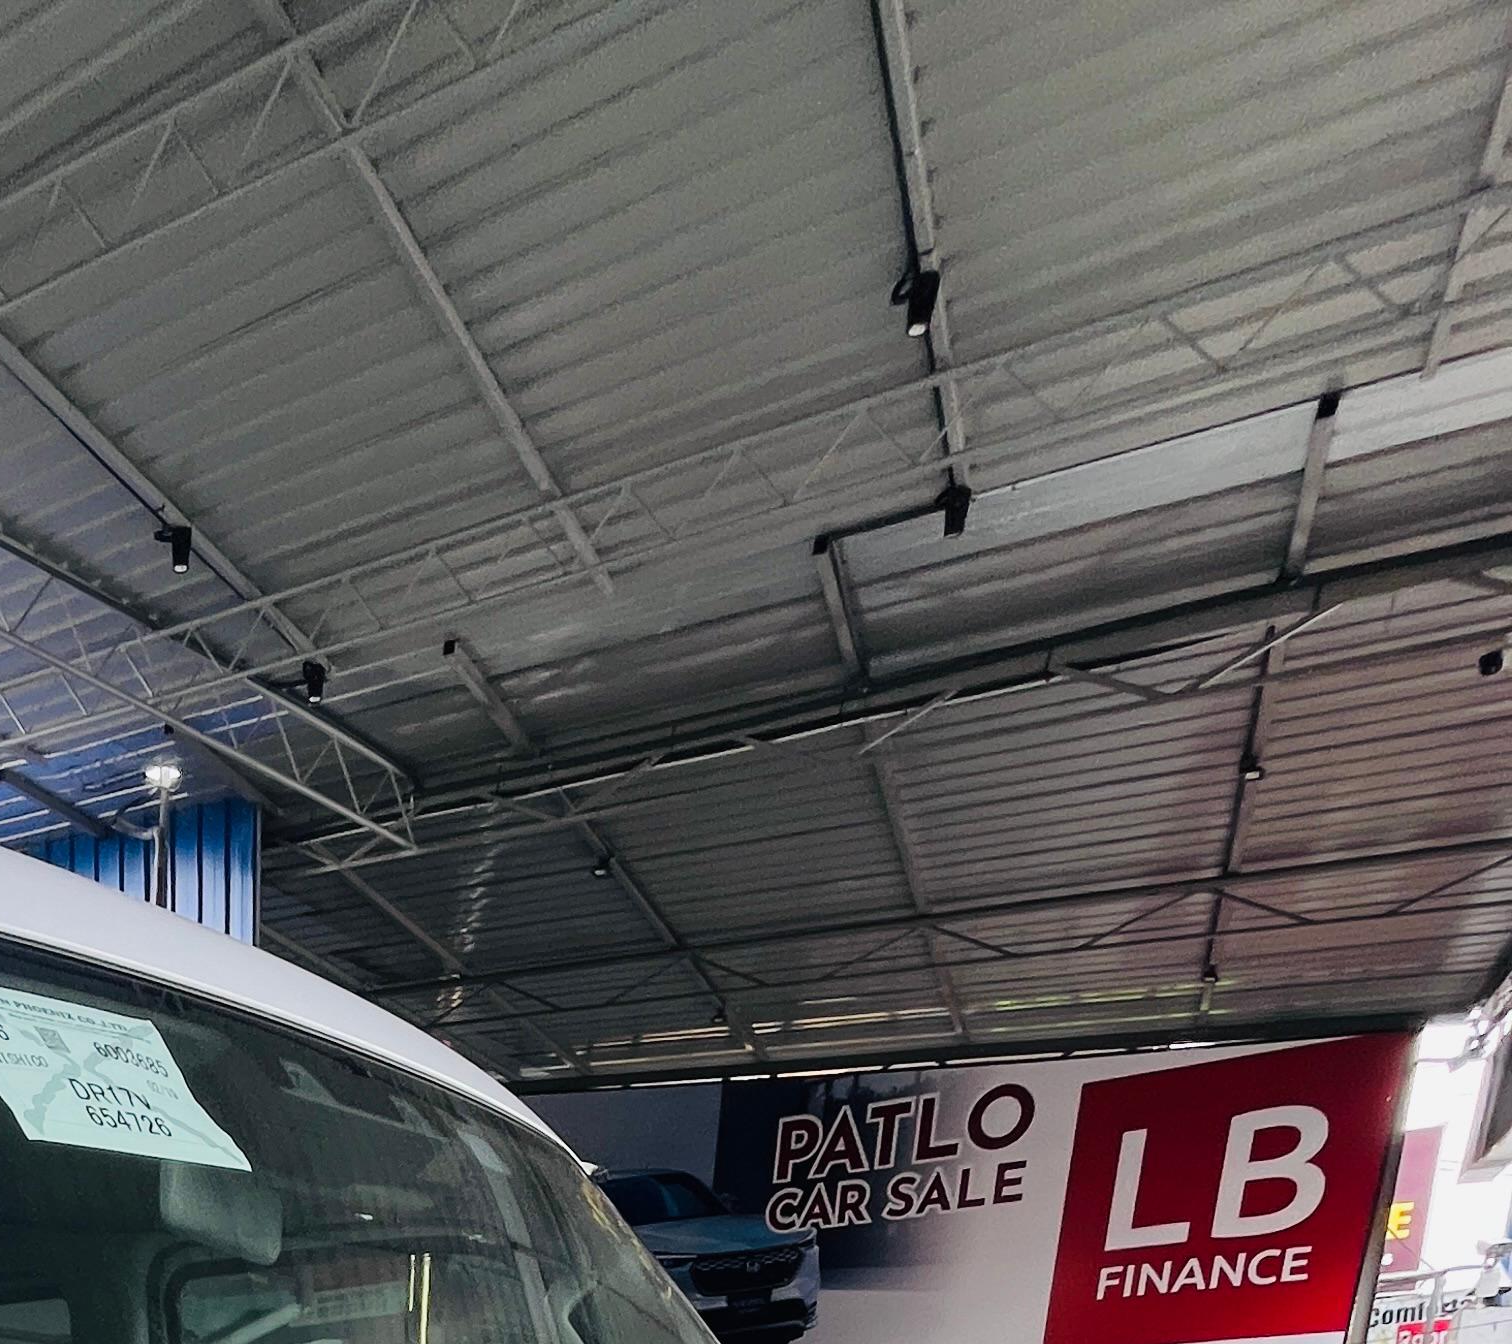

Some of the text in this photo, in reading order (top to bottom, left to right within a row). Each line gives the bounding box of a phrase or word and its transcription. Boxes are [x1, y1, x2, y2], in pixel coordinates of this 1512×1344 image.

[85, 1105, 172, 1137] 654726
[772, 1083, 1036, 1184] PATLO
[765, 1159, 1028, 1234] CAR SALE
[1104, 1104, 1329, 1251] LB
[1096, 1245, 1313, 1301] FINANCE
